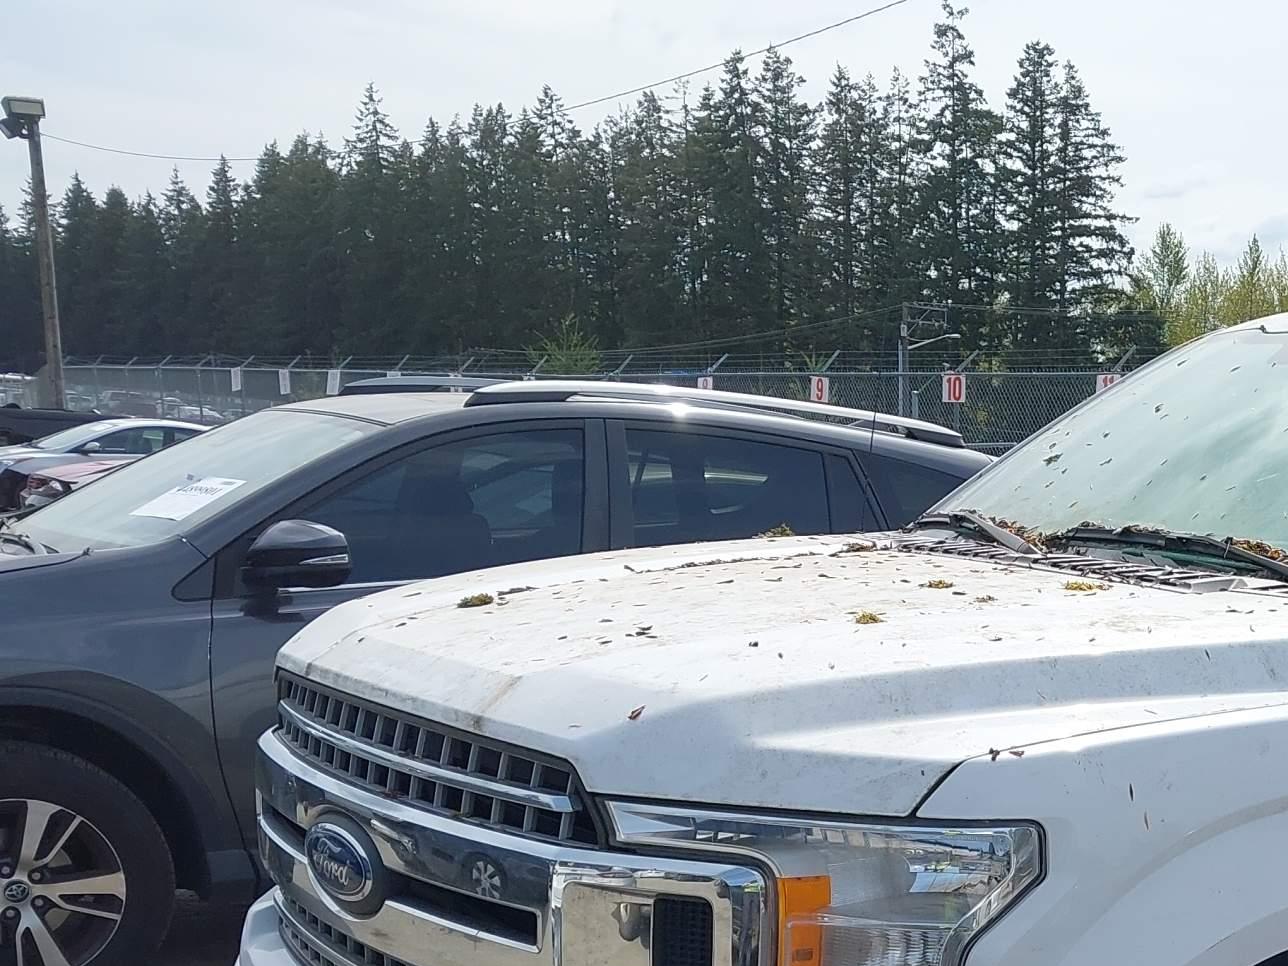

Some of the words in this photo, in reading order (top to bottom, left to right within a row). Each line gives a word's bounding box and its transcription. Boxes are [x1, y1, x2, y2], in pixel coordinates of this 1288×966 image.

[816, 378, 824, 400] 9
[946, 376, 962, 401] 10
[312, 837, 350, 887] Ford
